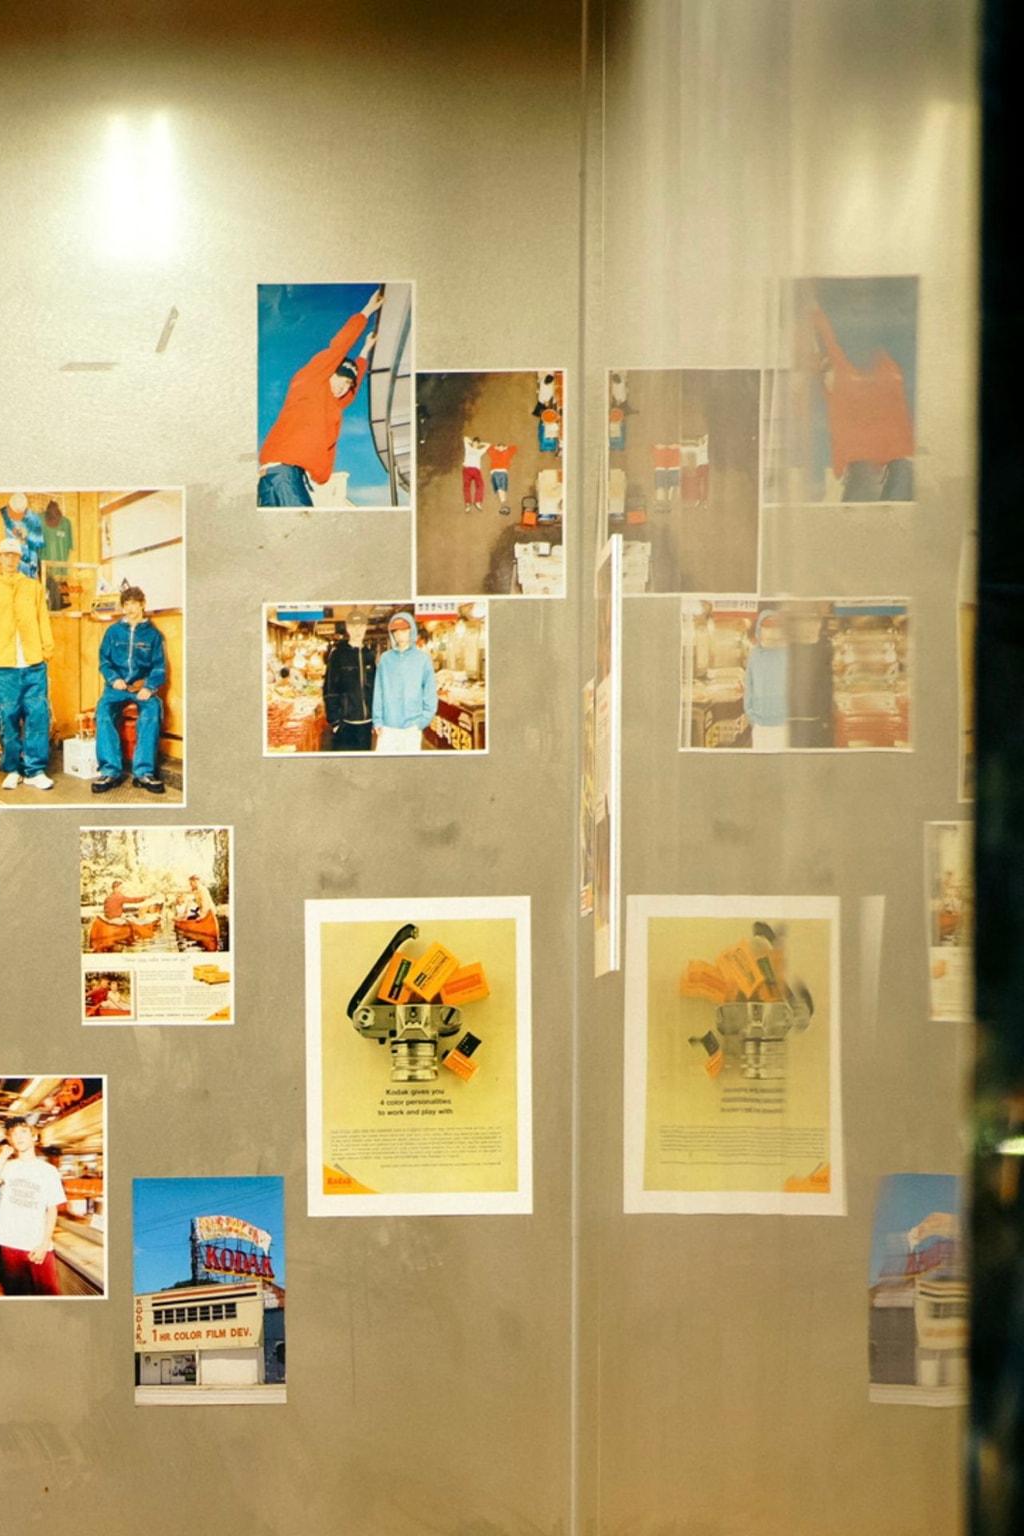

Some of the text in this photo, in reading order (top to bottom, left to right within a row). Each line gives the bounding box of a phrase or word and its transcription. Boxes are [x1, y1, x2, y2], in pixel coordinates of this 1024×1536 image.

[405, 1098, 452, 1106] personalities
[205, 1244, 275, 1278] KODAK
[135, 1298, 143, 1340] KODAK
[152, 1328, 157, 1342] 1
[174, 1330, 202, 1341] COLOR
[206, 1328, 226, 1339] FILM
[230, 1327, 252, 1338] DEV.
